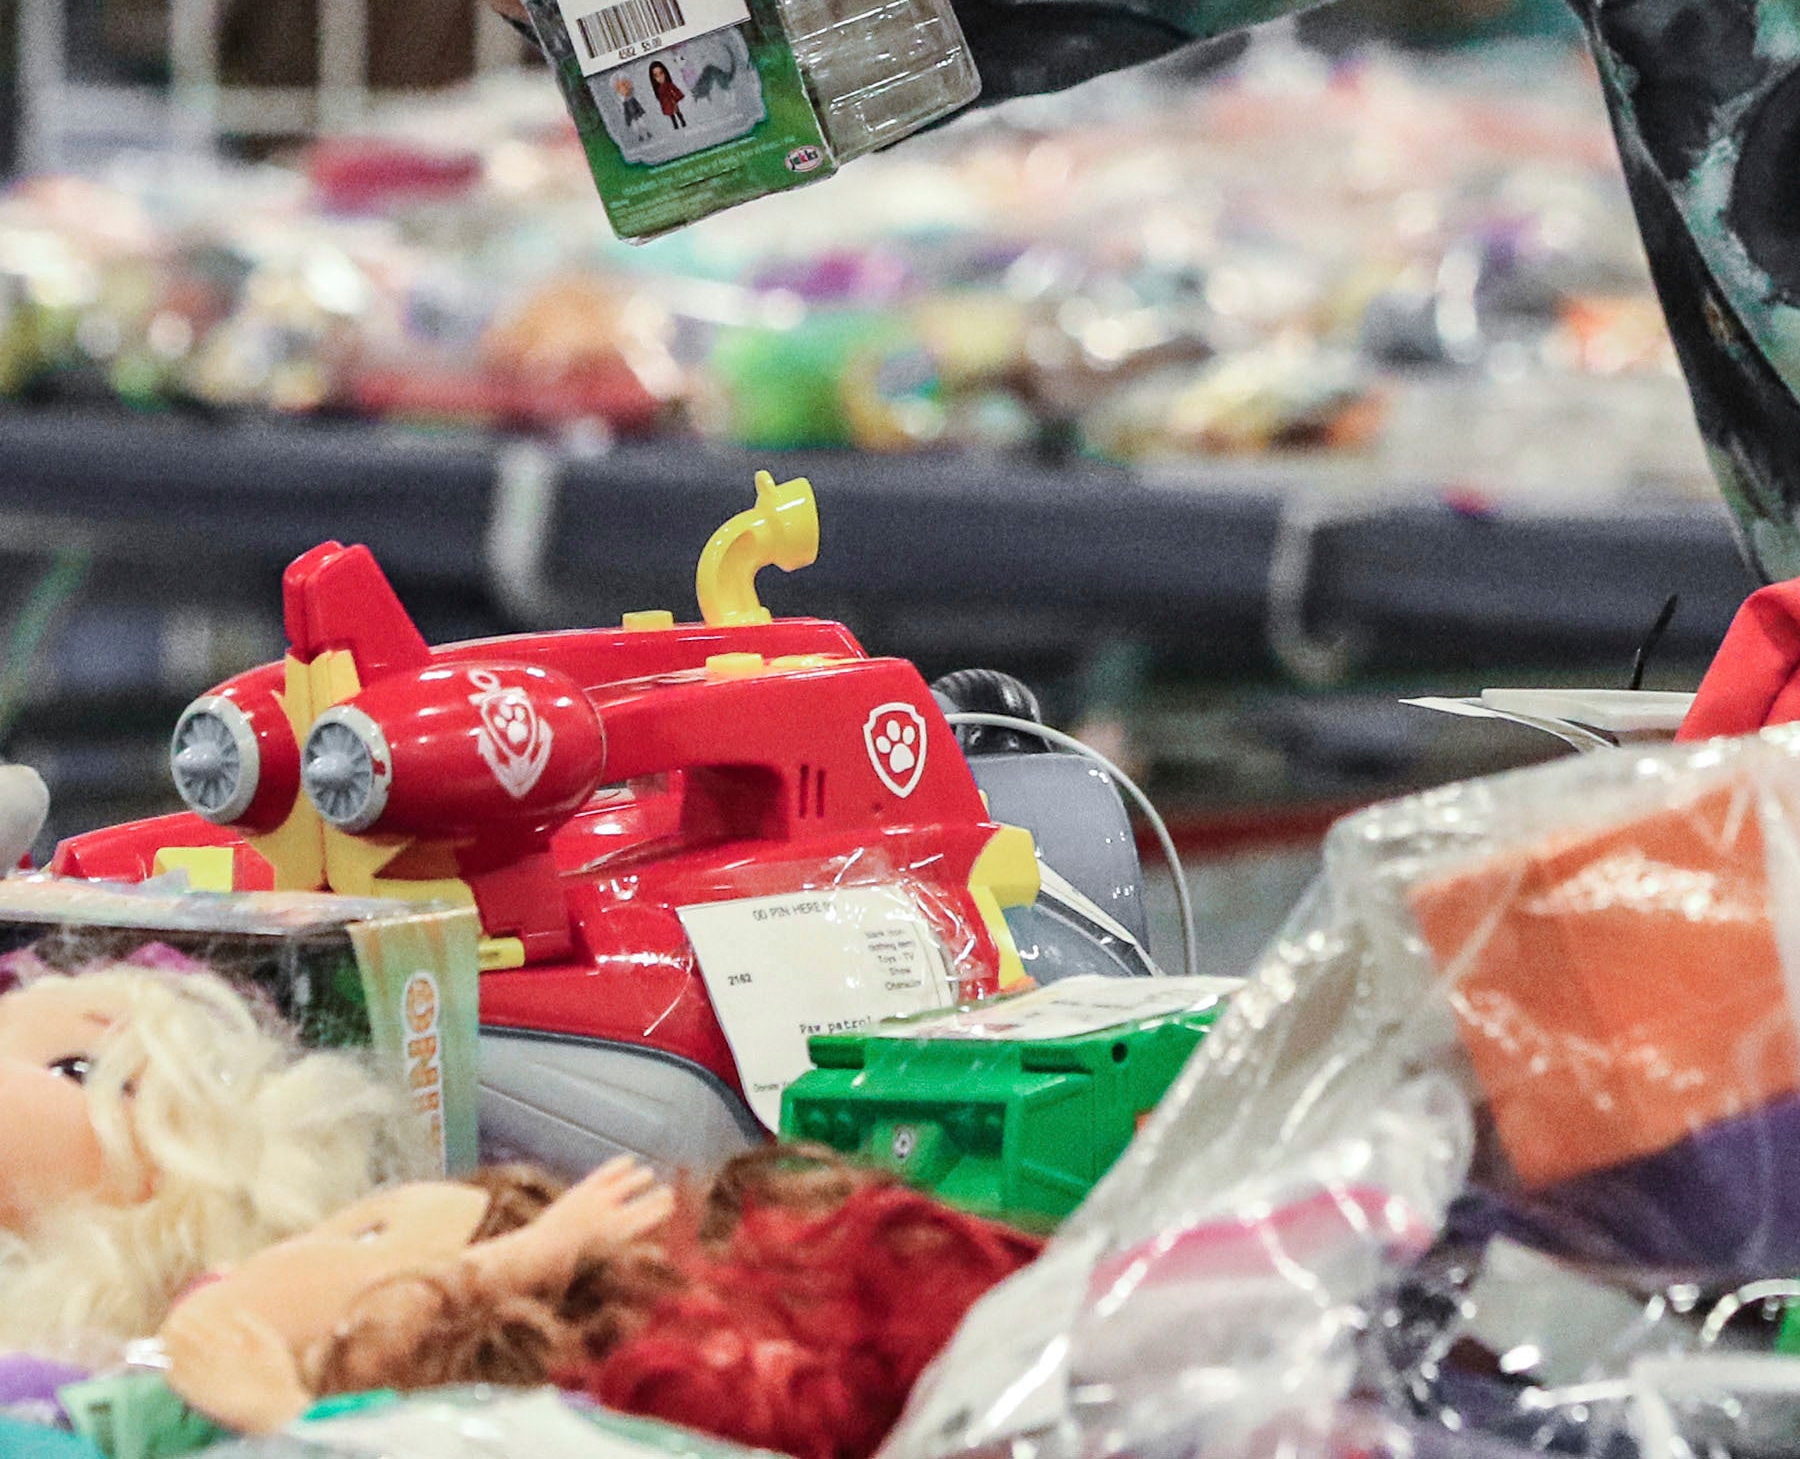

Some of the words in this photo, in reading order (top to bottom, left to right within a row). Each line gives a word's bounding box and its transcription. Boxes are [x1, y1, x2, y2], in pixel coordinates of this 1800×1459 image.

[769, 906, 791, 920] PIN
[792, 900, 821, 915] HERE
[799, 1021, 822, 1035] Paw
[827, 1015, 873, 1034] patrol
